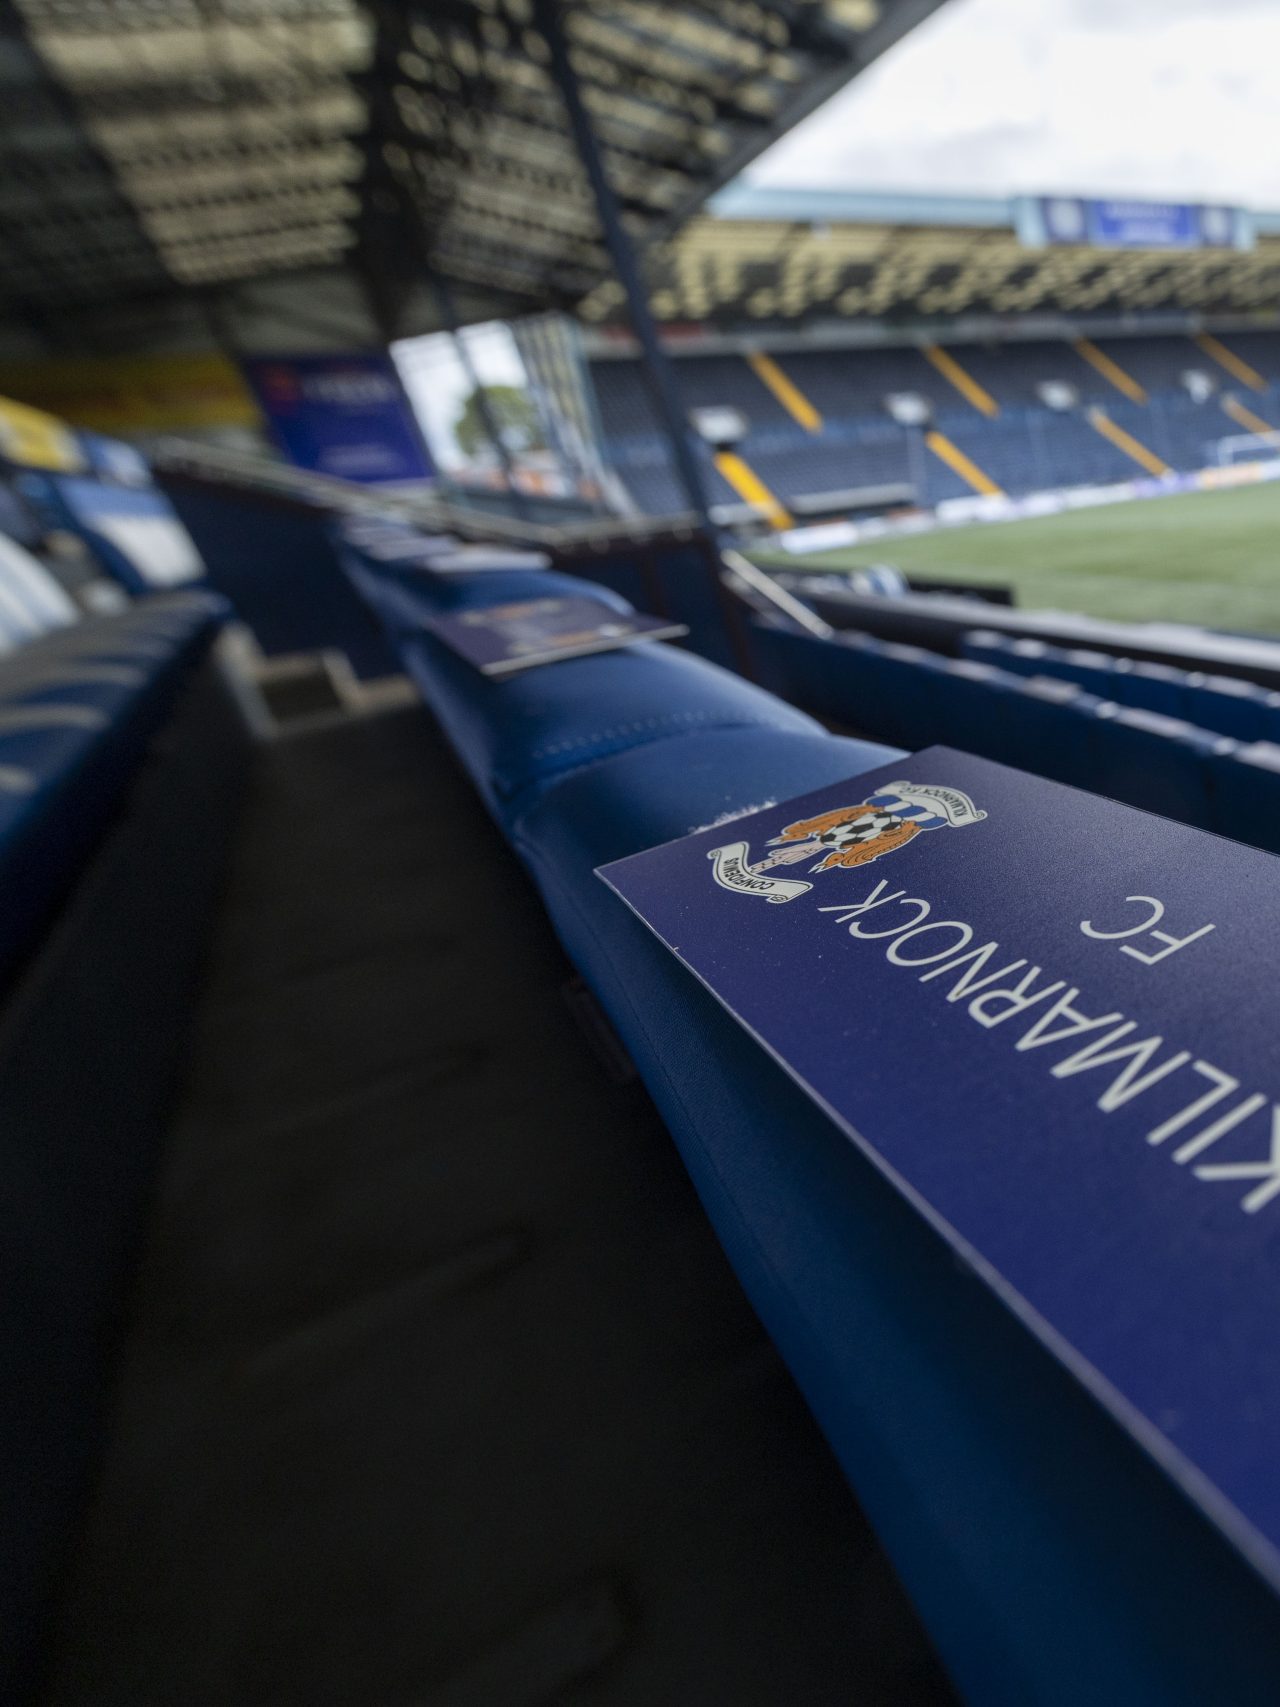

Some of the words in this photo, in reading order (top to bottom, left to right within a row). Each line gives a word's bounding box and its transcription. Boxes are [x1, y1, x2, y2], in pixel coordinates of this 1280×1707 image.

[922, 788, 968, 818] KILMARNOCK
[723, 857, 775, 890] CONFIDEMUS
[1080, 895, 1216, 965] FC
